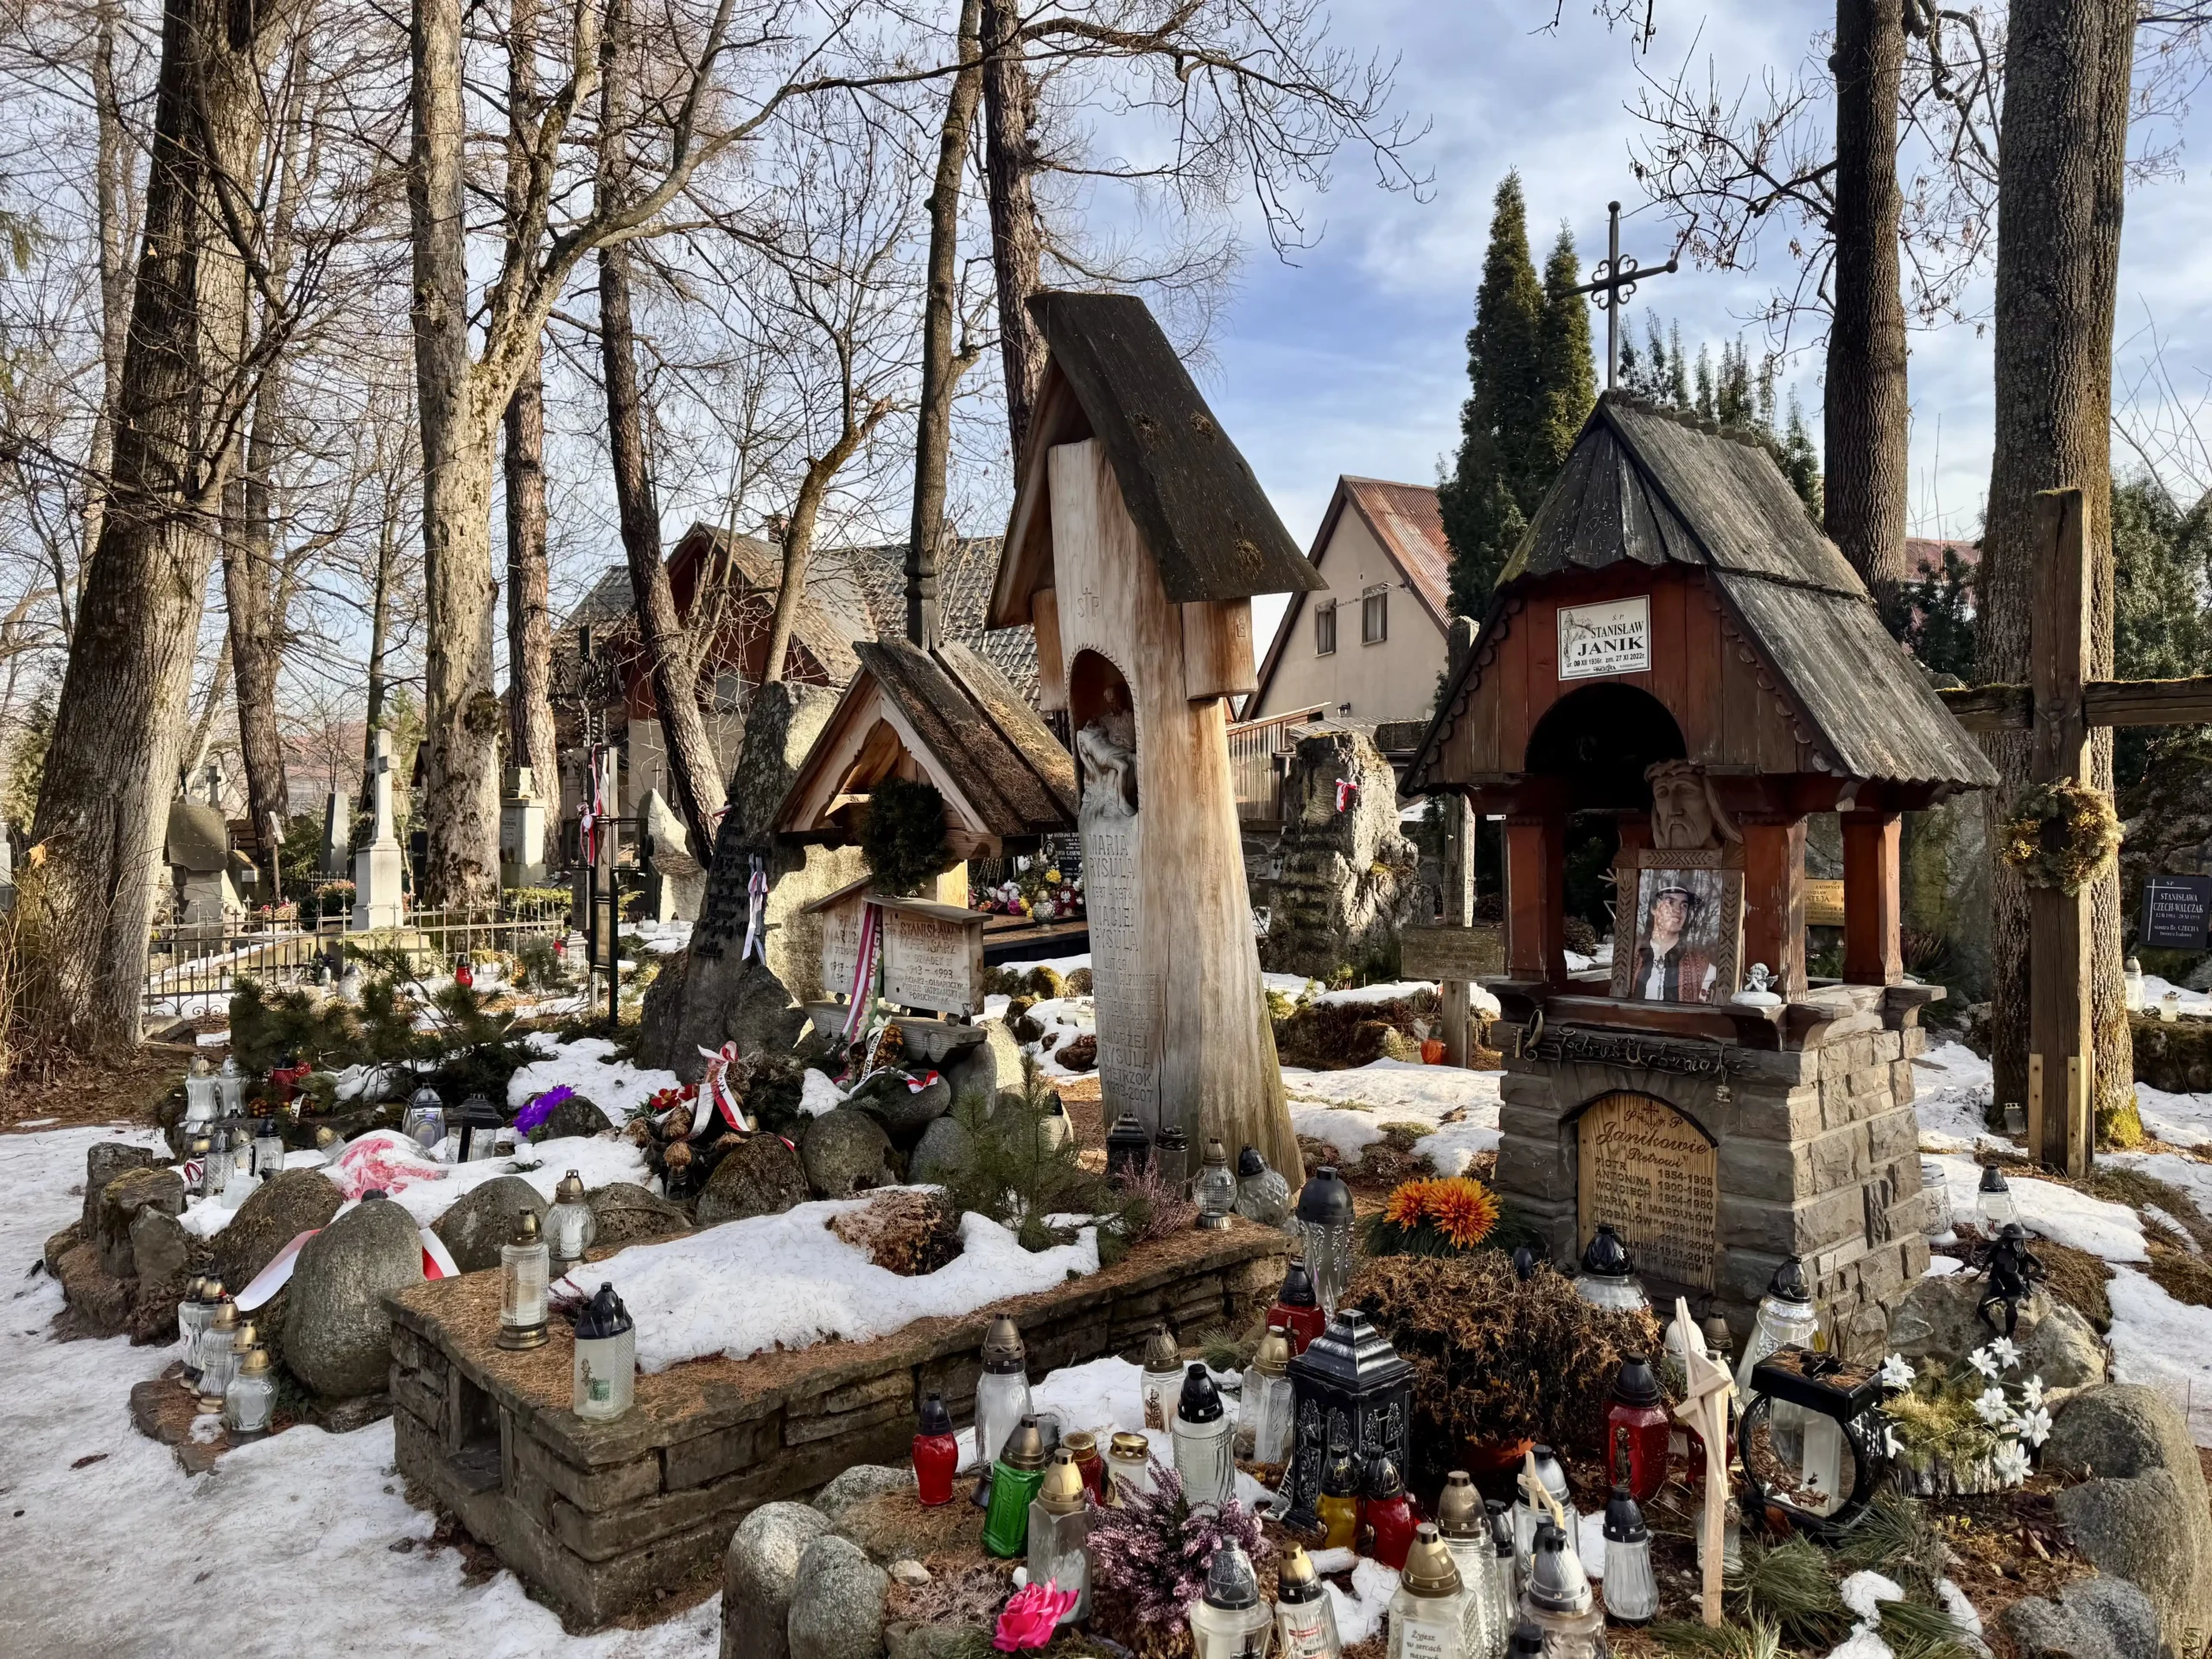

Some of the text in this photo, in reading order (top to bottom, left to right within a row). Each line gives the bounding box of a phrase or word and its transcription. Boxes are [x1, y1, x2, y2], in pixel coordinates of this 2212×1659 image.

[1591, 620, 1644, 639] STANISŁAW
[1577, 636, 1645, 657] JANIK
[1089, 835, 1128, 856] MARIA
[2153, 902, 2204, 913] CZECH-WALCZAK
[2161, 893, 2198, 902] STANISŁAWA
[899, 921, 955, 941] STANISŁAW
[934, 969, 954, 979] 1993
[1102, 1030, 1148, 1049] ANDRZEJ
[1104, 1064, 1153, 1086] PIETRZOK
[1596, 1122, 1710, 1154] Janikowie
[1594, 1156, 1713, 1186] PIOTR 1854-1905
[1594, 1169, 1713, 1198] ANTONINA 1900-1980
[1594, 1180, 1713, 1211] WOJCIECH 1904-1980
[1594, 1193, 1630, 1211] MARIA
[1649, 1204, 1713, 1224] MARDUŁÓW
[1659, 1220, 1714, 1240] 1908-1991
[1659, 1246, 1714, 1267] 1931-2012
[1662, 1254, 1704, 1274] DUSZOM
[1411, 1630, 1436, 1642] Żyjesz
[1415, 1643, 1442, 1653] sercach
